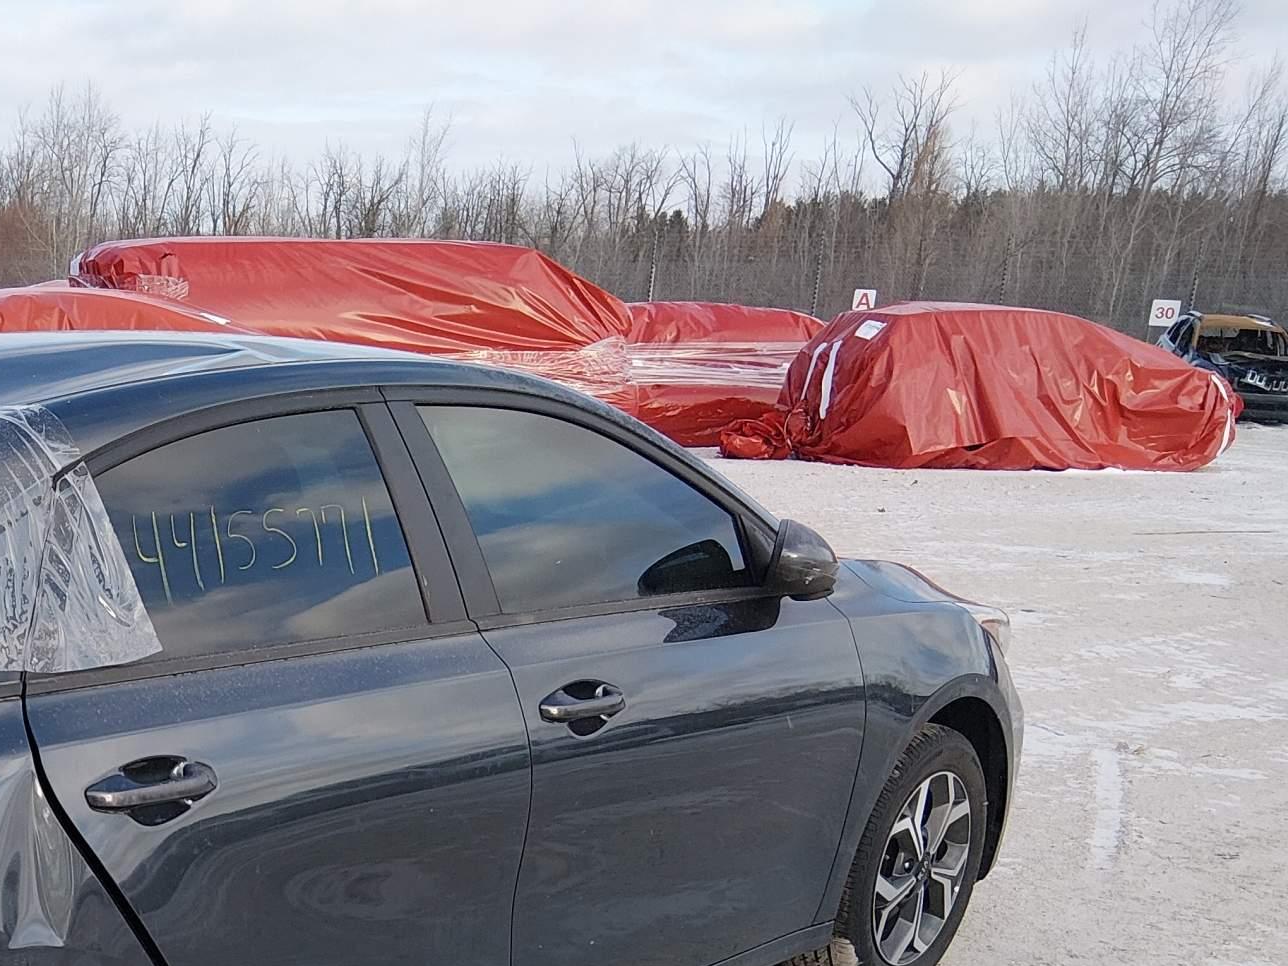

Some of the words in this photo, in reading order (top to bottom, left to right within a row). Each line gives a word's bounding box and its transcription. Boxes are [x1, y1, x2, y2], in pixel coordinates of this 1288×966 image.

[855, 292, 871, 310] A
[1155, 306, 1175, 320] 30
[132, 496, 379, 605] 44155771
